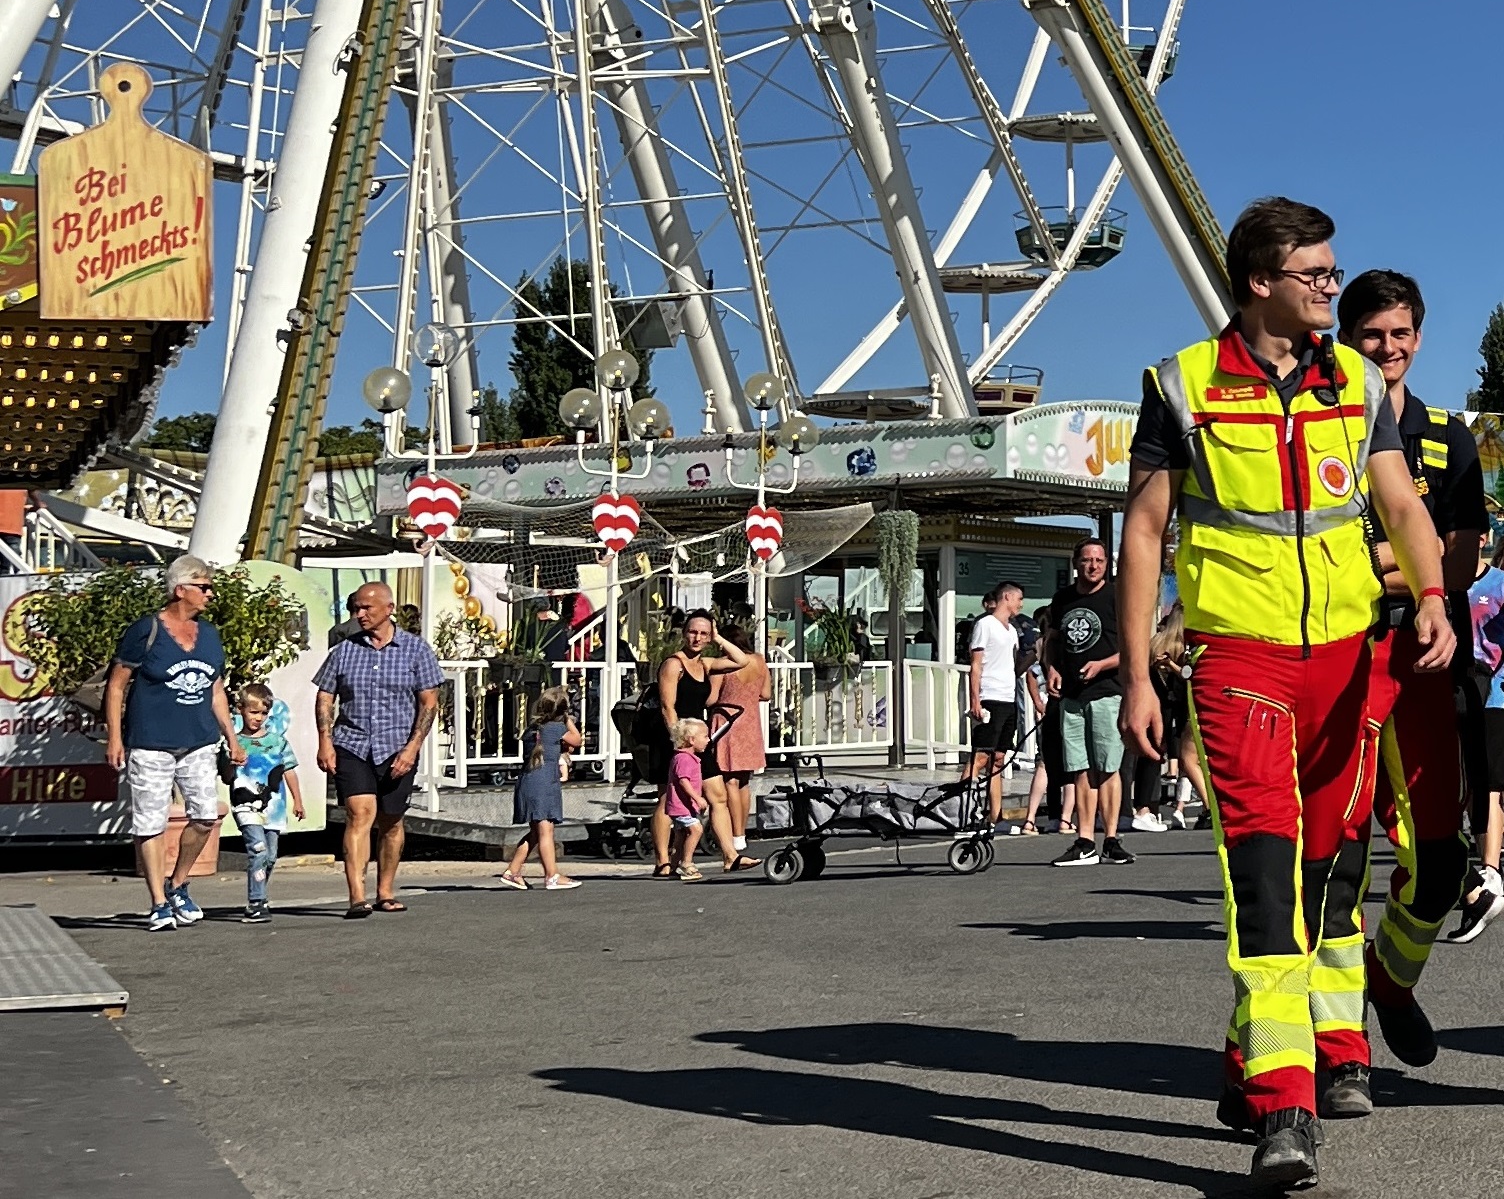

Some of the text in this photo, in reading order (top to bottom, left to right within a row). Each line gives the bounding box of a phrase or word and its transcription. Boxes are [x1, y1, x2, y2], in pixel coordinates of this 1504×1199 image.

[75, 163, 127, 206] Bei
[53, 195, 163, 254] Blume
[76, 197, 203, 284] schmeckts!
[11, 768, 86, 801] Hilfe
